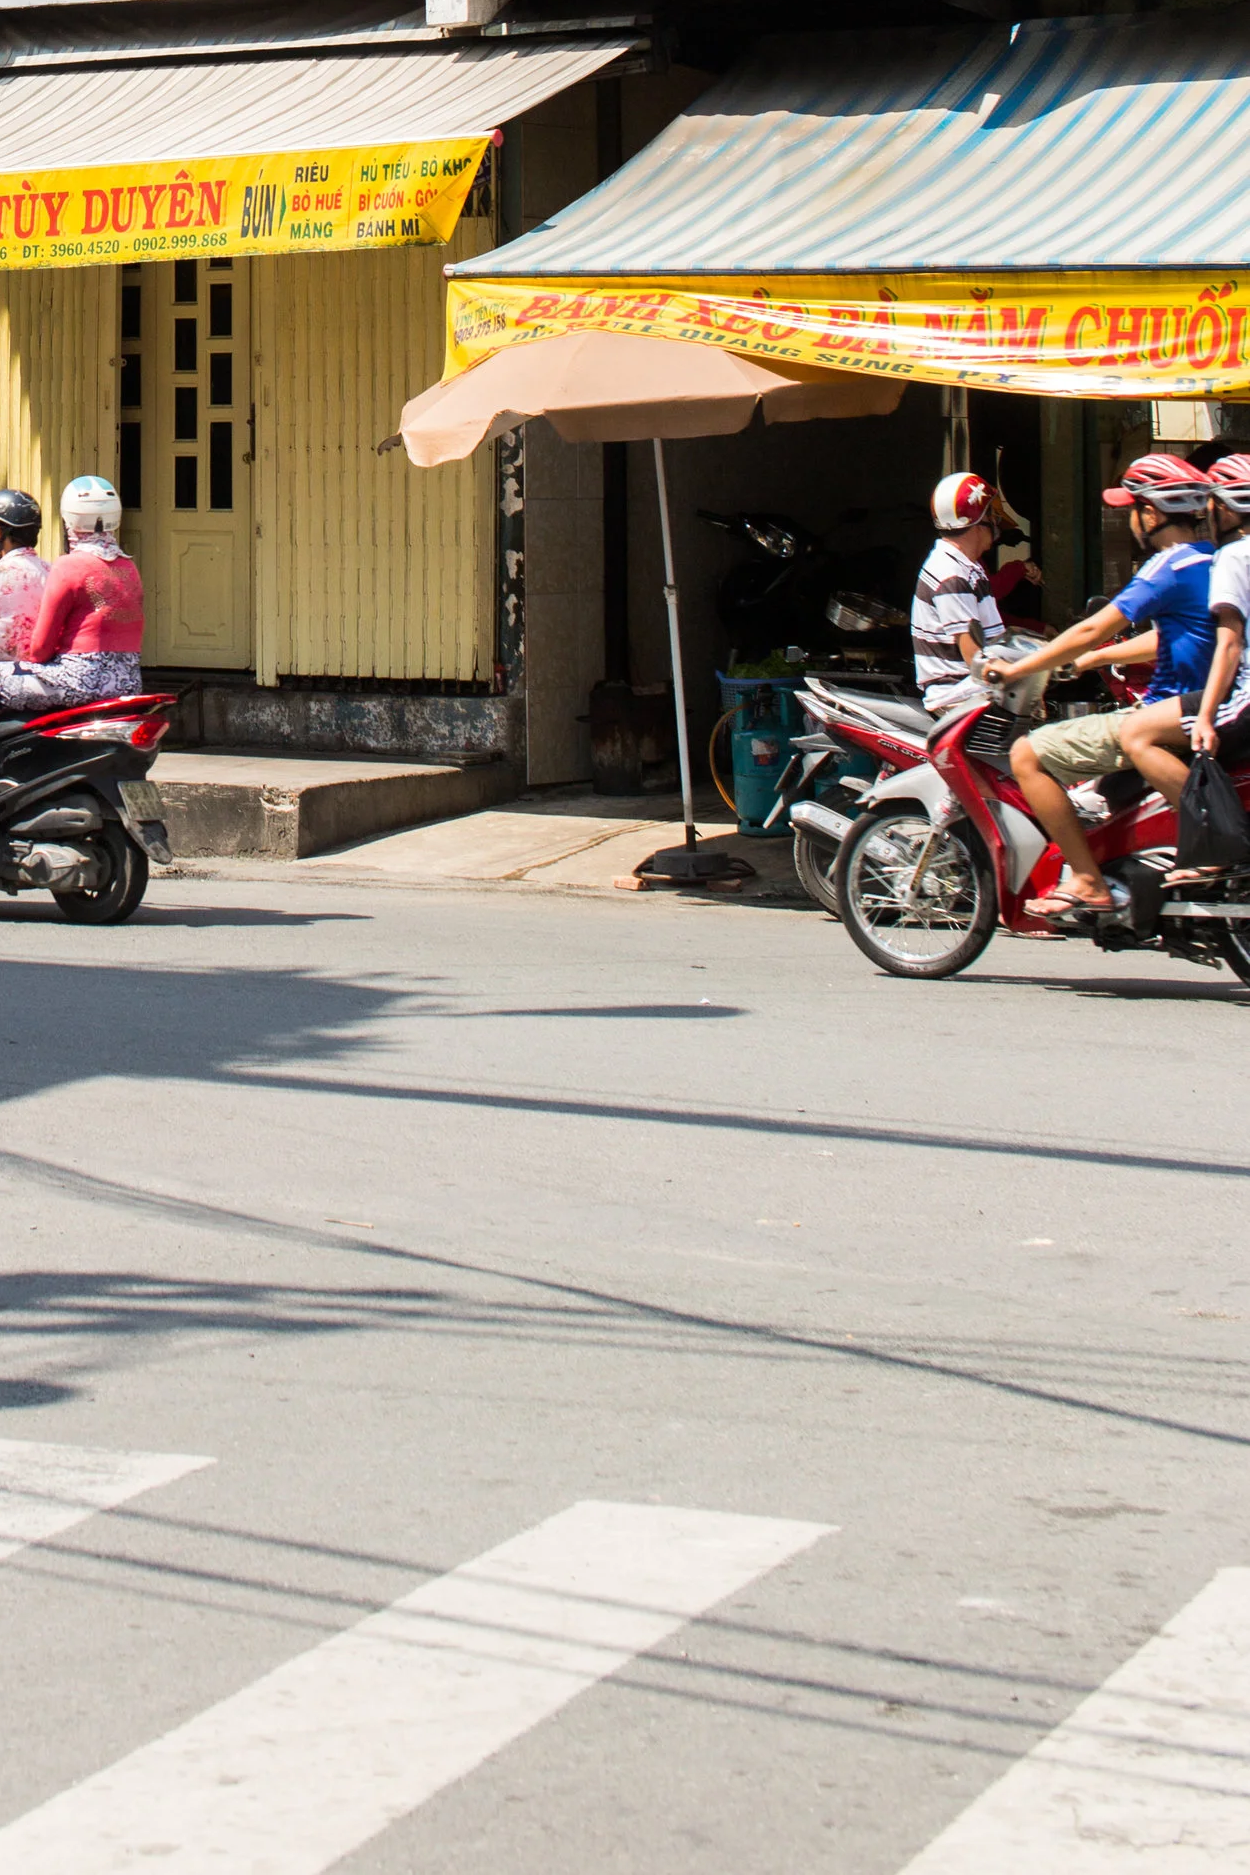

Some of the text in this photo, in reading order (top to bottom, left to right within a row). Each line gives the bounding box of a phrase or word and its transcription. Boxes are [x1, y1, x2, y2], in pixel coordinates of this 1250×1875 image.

[294, 162, 330, 184] RIÊU
[360, 158, 379, 183] HỦ
[382, 155, 411, 182] TIẾU
[420, 155, 439, 178] BÒ
[81, 169, 231, 235] DUYÊN
[240, 168, 277, 239] BÚN
[291, 184, 344, 212] BÒ HUẾ
[358, 190, 371, 212] BÌ
[373, 183, 405, 210] CUỐN
[290, 218, 334, 241] MĂNG
[356, 213, 421, 239] BÁNH MÌ
[22, 244, 46, 259] ĐT:
[49, 239, 121, 258] 3960.4520
[132, 232, 228, 252] 0902.999.868
[514, 288, 678, 327] BÁNH
[675, 287, 811, 343] XÈO
[1064, 279, 1250, 370] CHUỐI
[677, 328, 802, 358] QUANG
[814, 352, 916, 375] SUNG
